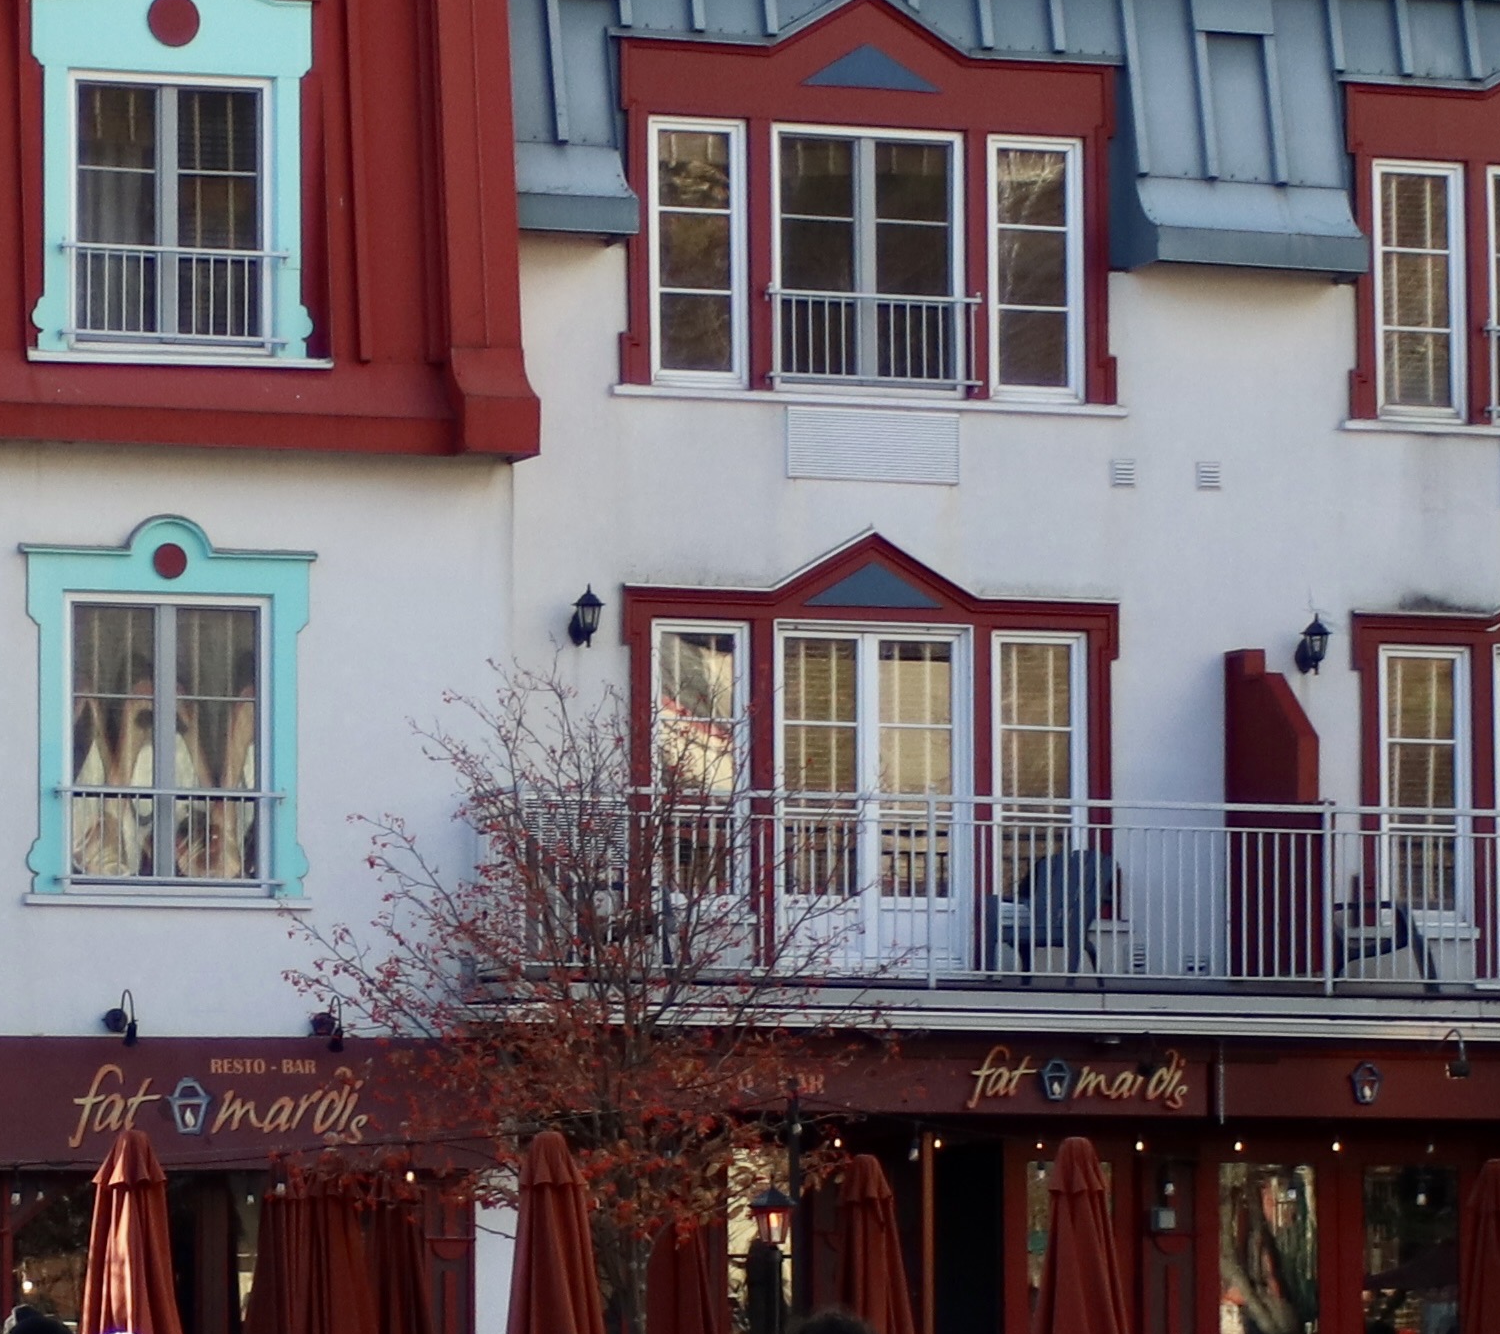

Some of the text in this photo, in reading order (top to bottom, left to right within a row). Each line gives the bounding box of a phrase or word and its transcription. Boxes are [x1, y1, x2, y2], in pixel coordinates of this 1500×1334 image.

[210, 1059, 265, 1074] RESTO
[282, 1059, 317, 1074] BAR
[966, 1045, 1037, 1109] fat
[68, 1063, 369, 1148] fat mardis
